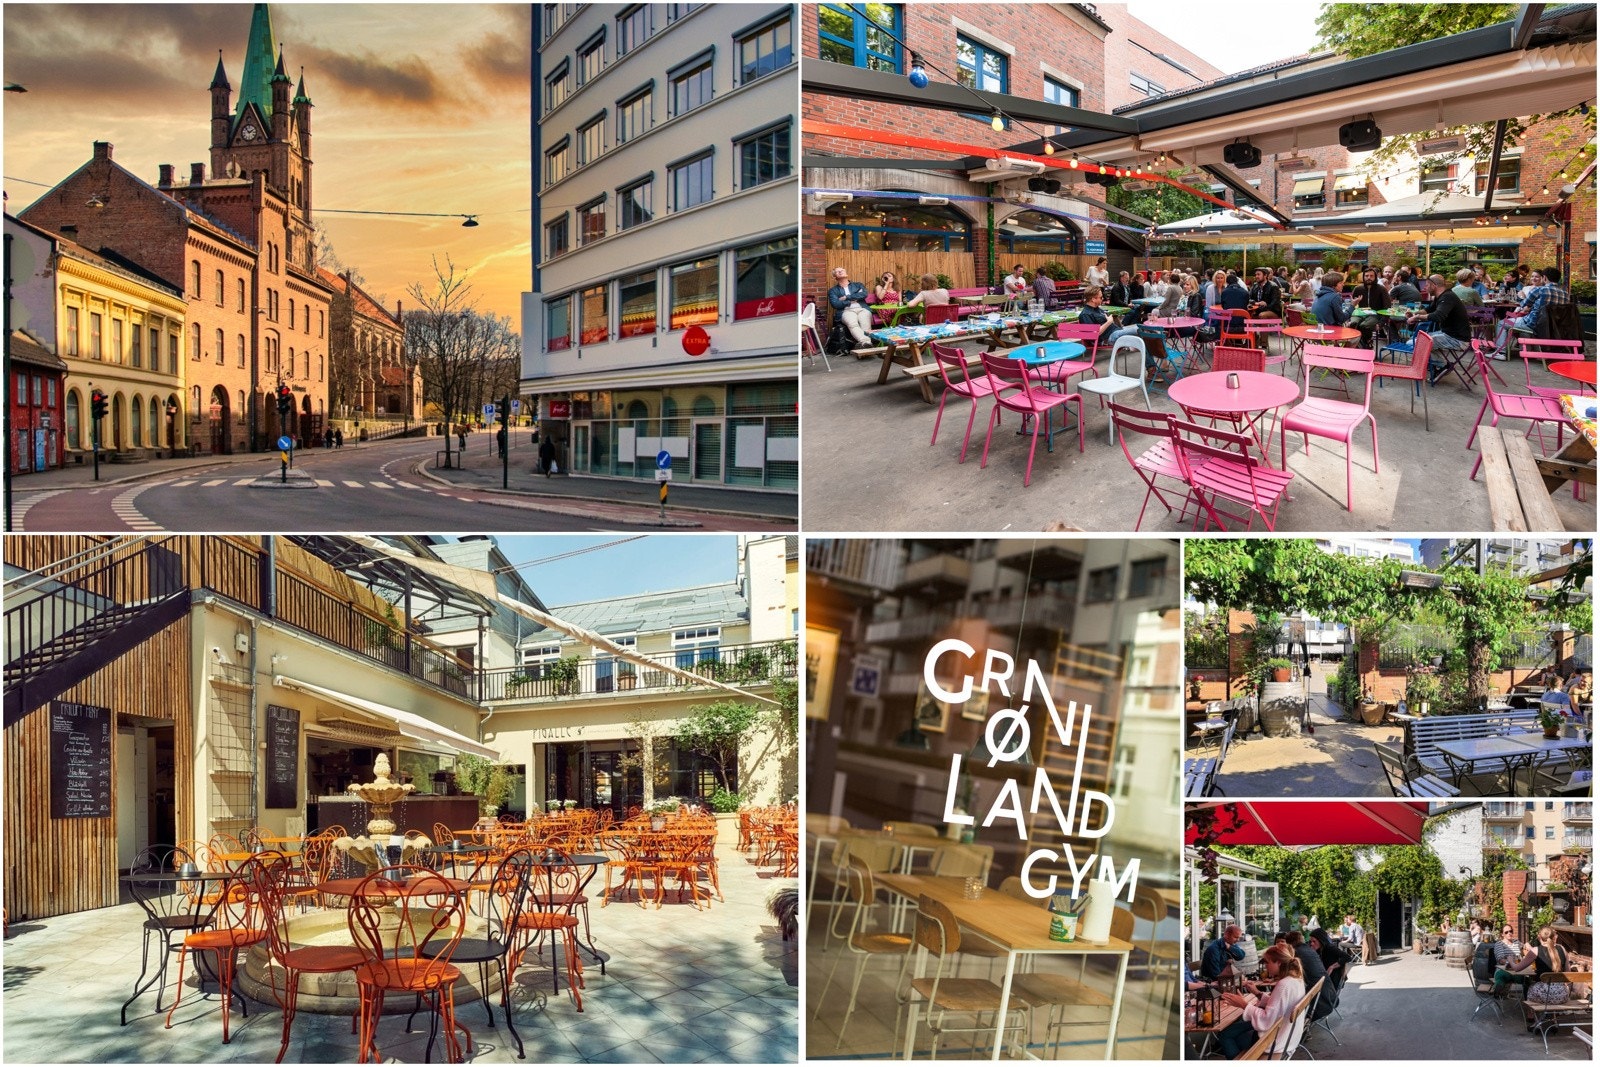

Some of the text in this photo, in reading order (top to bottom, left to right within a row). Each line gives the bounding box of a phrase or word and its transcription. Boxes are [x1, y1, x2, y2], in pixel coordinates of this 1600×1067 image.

[756, 300, 775, 317] fresh
[686, 337, 707, 345] EXTRA
[1020, 842, 1141, 903] GYM
